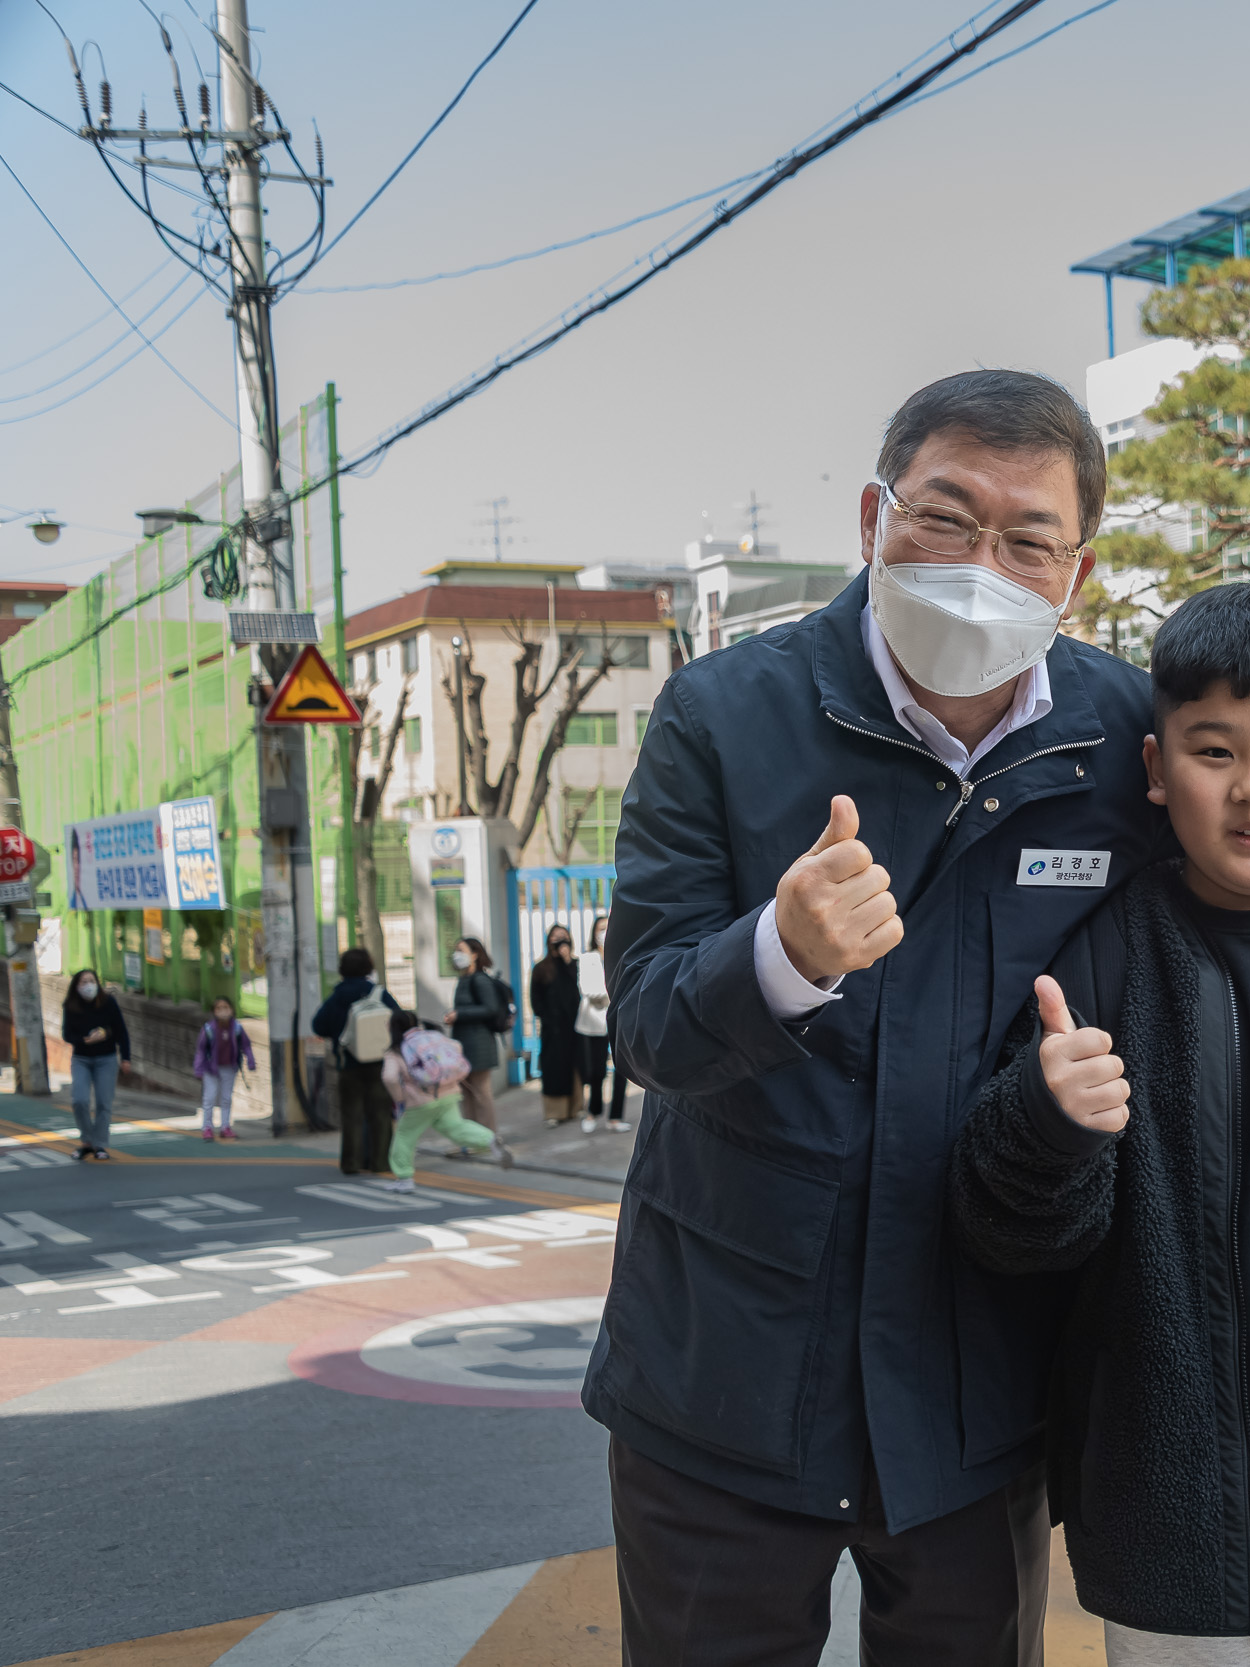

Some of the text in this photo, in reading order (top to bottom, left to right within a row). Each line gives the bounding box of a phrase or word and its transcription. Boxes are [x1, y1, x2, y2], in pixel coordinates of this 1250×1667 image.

[0, 836, 27, 856] 지
[0, 856, 28, 876] OP
[1051, 857, 1102, 870] 김경호
[1056, 872, 1093, 881] 광진구청장
